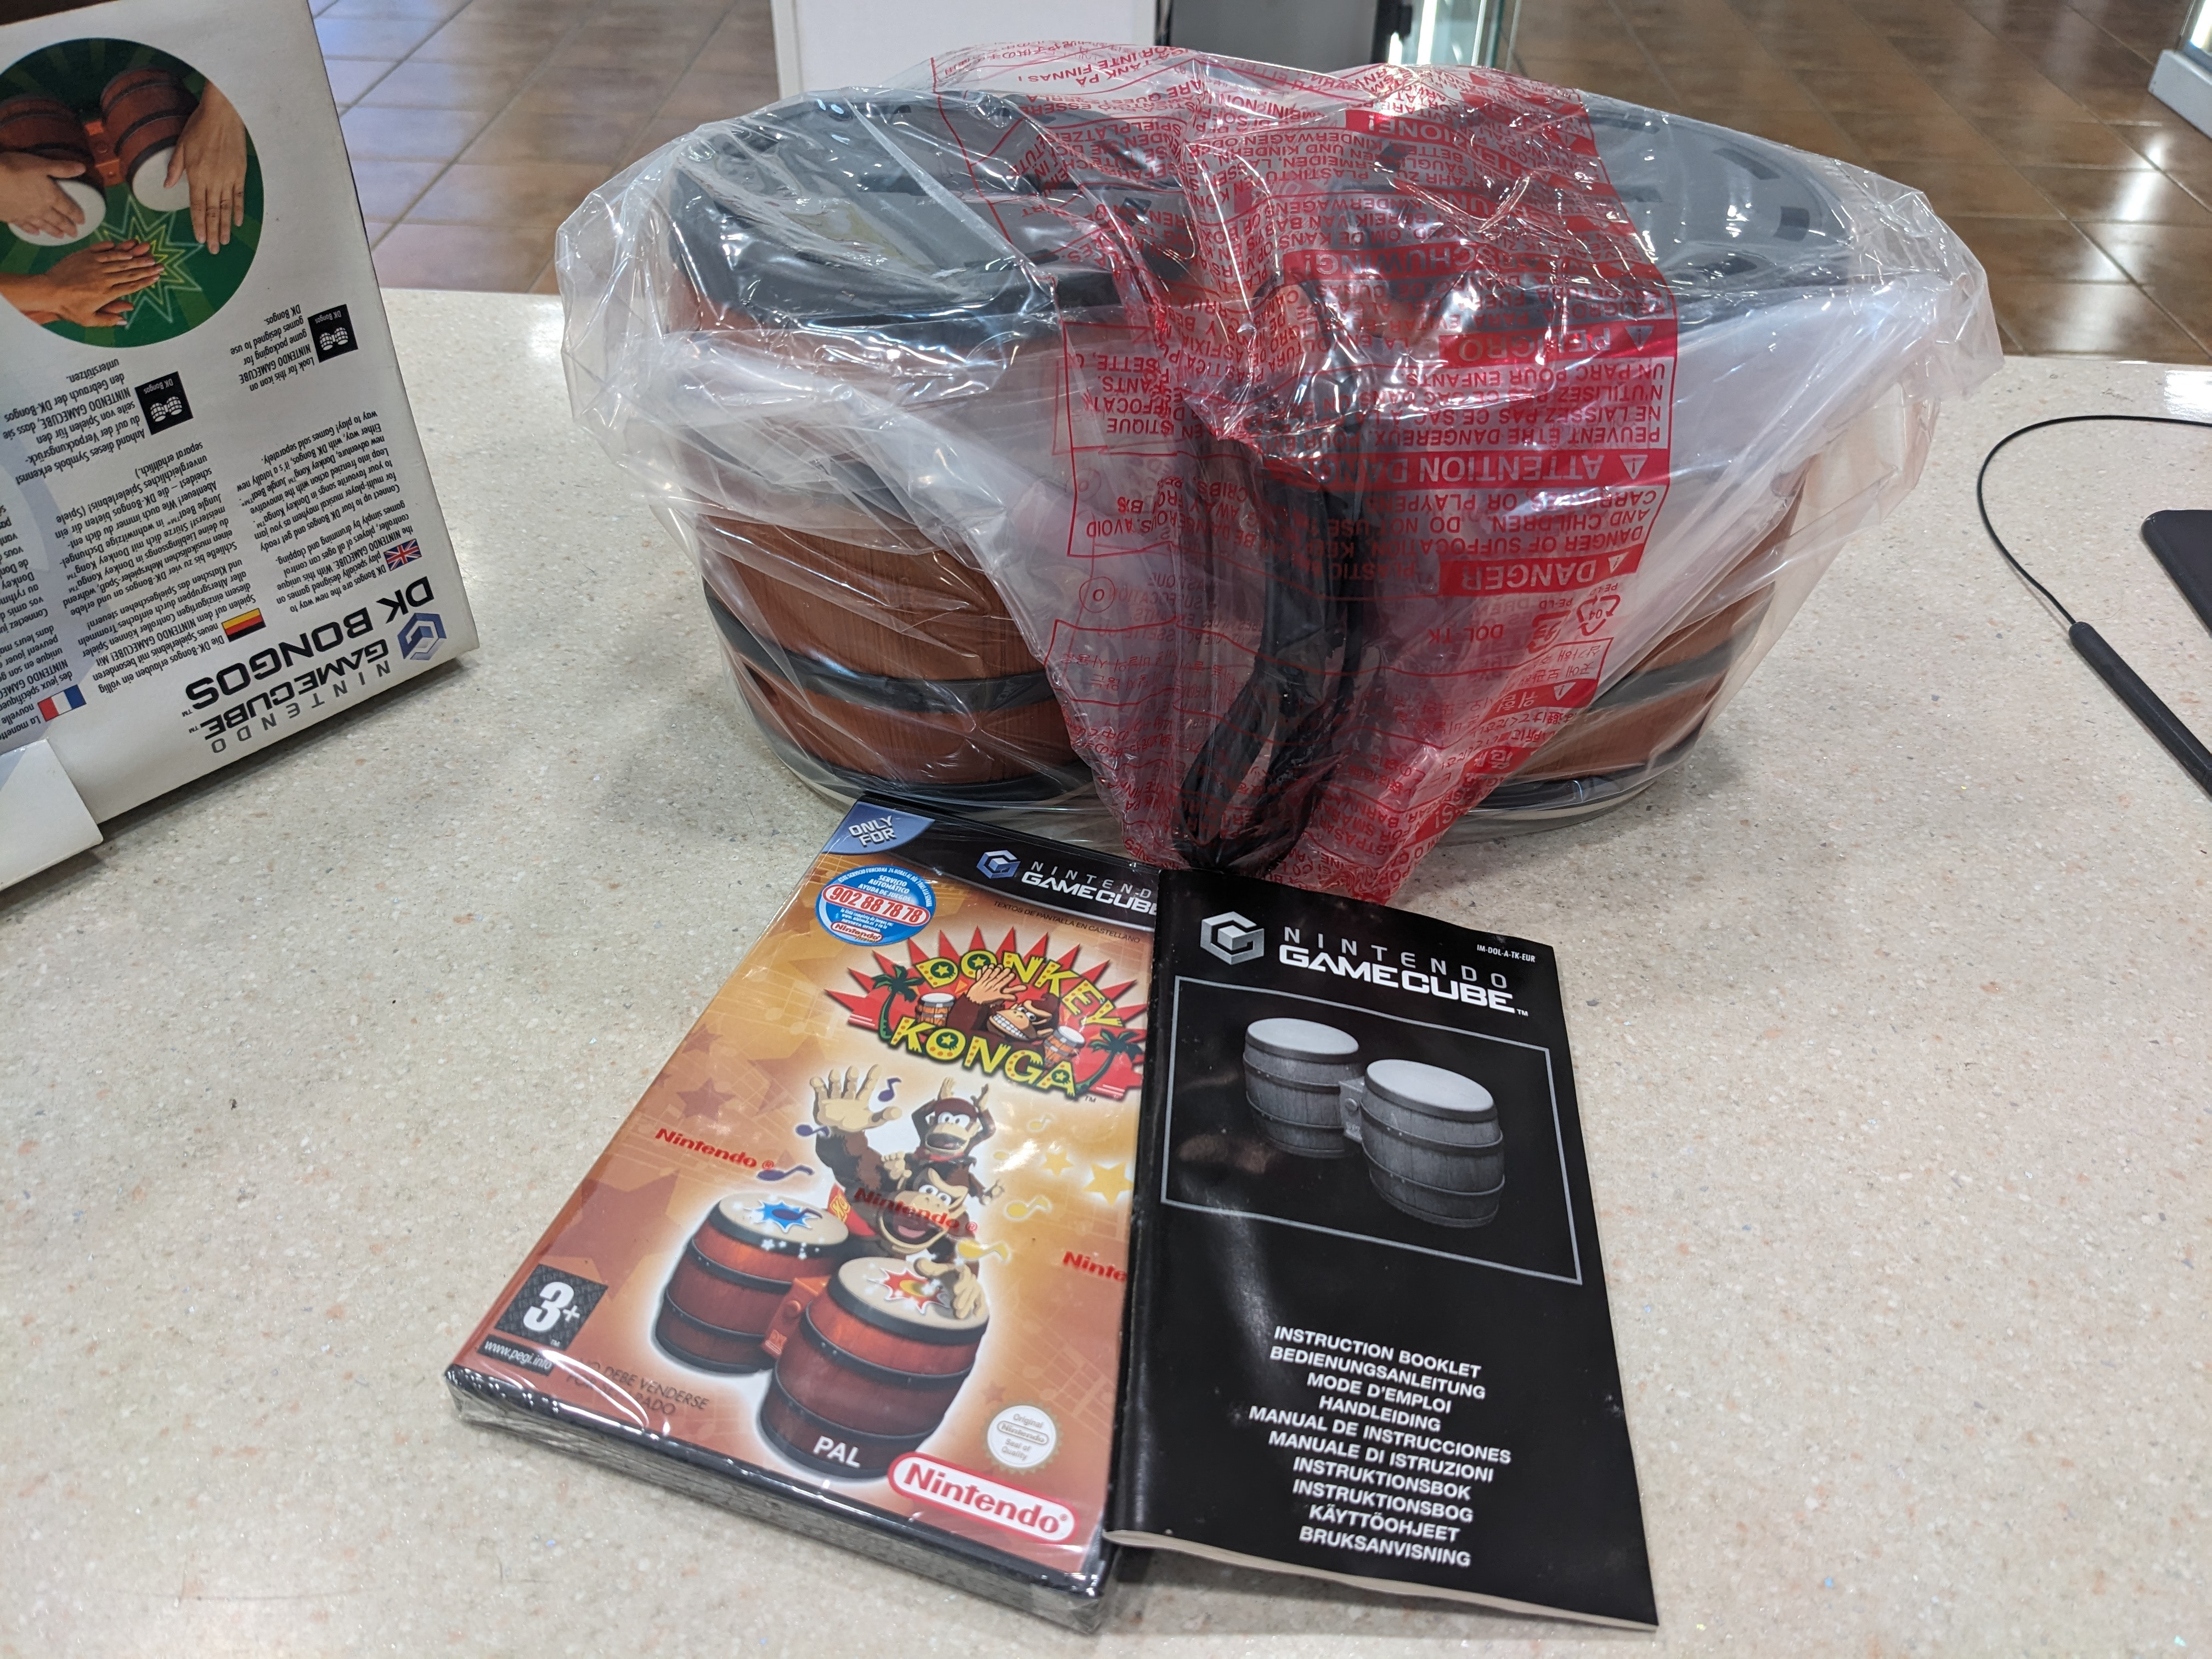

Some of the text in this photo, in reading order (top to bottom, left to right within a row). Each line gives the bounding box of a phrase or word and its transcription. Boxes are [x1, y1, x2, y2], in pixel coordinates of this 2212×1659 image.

[1028, 61, 1091, 81] FINNAS
[263, 303, 301, 325] DK Bongos.
[315, 311, 342, 324] DK Bongos
[229, 314, 304, 355] games designed to use
[243, 328, 307, 366] game packaging for
[238, 343, 312, 384] NINTENDO GAMECUBE
[249, 356, 315, 391] Look for this icon on
[1509, 368, 1567, 385] POUR
[1575, 364, 1630, 382] PARC
[1637, 363, 1664, 380] UN
[143, 379, 173, 394] DK Bongos
[1464, 409, 1489, 425] CE
[1499, 408, 1534, 424] PAS
[1546, 406, 1627, 424] LAISSEZ
[1637, 405, 1660, 422] NE
[1568, 426, 1659, 444] PEUVENT
[14, 428, 145, 486] Anhand dieses Symbols erkennst
[1420, 454, 1603, 482] ATTENTION
[1487, 493, 1516, 510] OR
[1610, 507, 1650, 523] AND
[1086, 517, 1132, 537] AVOID
[1429, 515, 1460, 533] DO
[1565, 526, 1643, 549] DANGER
[276, 524, 414, 590] the NINTENDO GAMECUBE. With this unique
[1526, 535, 1556, 553] OF
[289, 563, 387, 612] DK Bongos are the new way to
[1460, 559, 1596, 590] DANGER
[95, 593, 256, 667] Spielen auf dem NINTENDO GAMECUBE! Mit
[185, 576, 434, 709] DK BONGOS
[40, 670, 72, 690] des jeux
[97, 634, 225, 693] Die DK-Bongos erlauben ein völlig
[200, 639, 389, 740] GAMECUBE
[212, 661, 391, 753] NINTENDO
[849, 815, 893, 837] ONLY
[859, 828, 896, 847] FOR
[858, 884, 879, 894] AYUDA
[887, 891, 911, 901] JUEGOS
[878, 874, 908, 887] SERVICIO
[1031, 861, 1152, 899] NINTEND
[830, 887, 862, 907] 902
[864, 895, 883, 912] 88
[883, 902, 903, 917] 78
[902, 906, 923, 923] 78
[994, 901, 1024, 913] TEXTOS
[1036, 912, 1075, 927] PANTALLA
[1088, 925, 1140, 943] CASTELLANO
[835, 923, 879, 940] Nintendo
[1285, 926, 1507, 989] NINTENDO
[1477, 944, 1536, 963] IM-DOL-A-TK-EUR
[915, 949, 1126, 1029] DONKEY
[1279, 944, 1515, 1013] GAMECUBE
[891, 1016, 1079, 1097] KONGA
[655, 1128, 757, 1168] Nintendo
[854, 1187, 960, 1230] Nintendo
[1063, 1250, 1127, 1282] Ninte
[523, 1281, 580, 1332] 3+
[484, 1340, 552, 1370] www.pegi.info
[1274, 1325, 1481, 1379] INSTRUCTION BOOKLET
[604, 1366, 636, 1386] DEBE
[640, 1377, 709, 1410] VENDERSE
[1269, 1346, 1486, 1400] BEDIENUNGSANLEITUNG
[1307, 1372, 1452, 1414] MODE D'EMPLOI
[1013, 1414, 1043, 1428] Original
[1319, 1396, 1441, 1432] HANDLEIDING
[1002, 1424, 1045, 1443] Nintendo
[1005, 1438, 1021, 1449] Seal
[1249, 1406, 1511, 1464] MANUAL DE INSTRUCCIONES
[813, 1434, 862, 1469] PAL
[1001, 1447, 1027, 1461] Quality
[1268, 1430, 1493, 1483] MANUALE DI ISTRUZIONI
[1293, 1456, 1471, 1500] INSTRUKTIONSBOK
[904, 1463, 1059, 1533] Nintendo
[1293, 1479, 1474, 1523] INSTRUKTIONSBOG
[1309, 1504, 1460, 1542] KÄYTTÖOHJEET
[1300, 1526, 1471, 1567] BRUKSANVISNING
